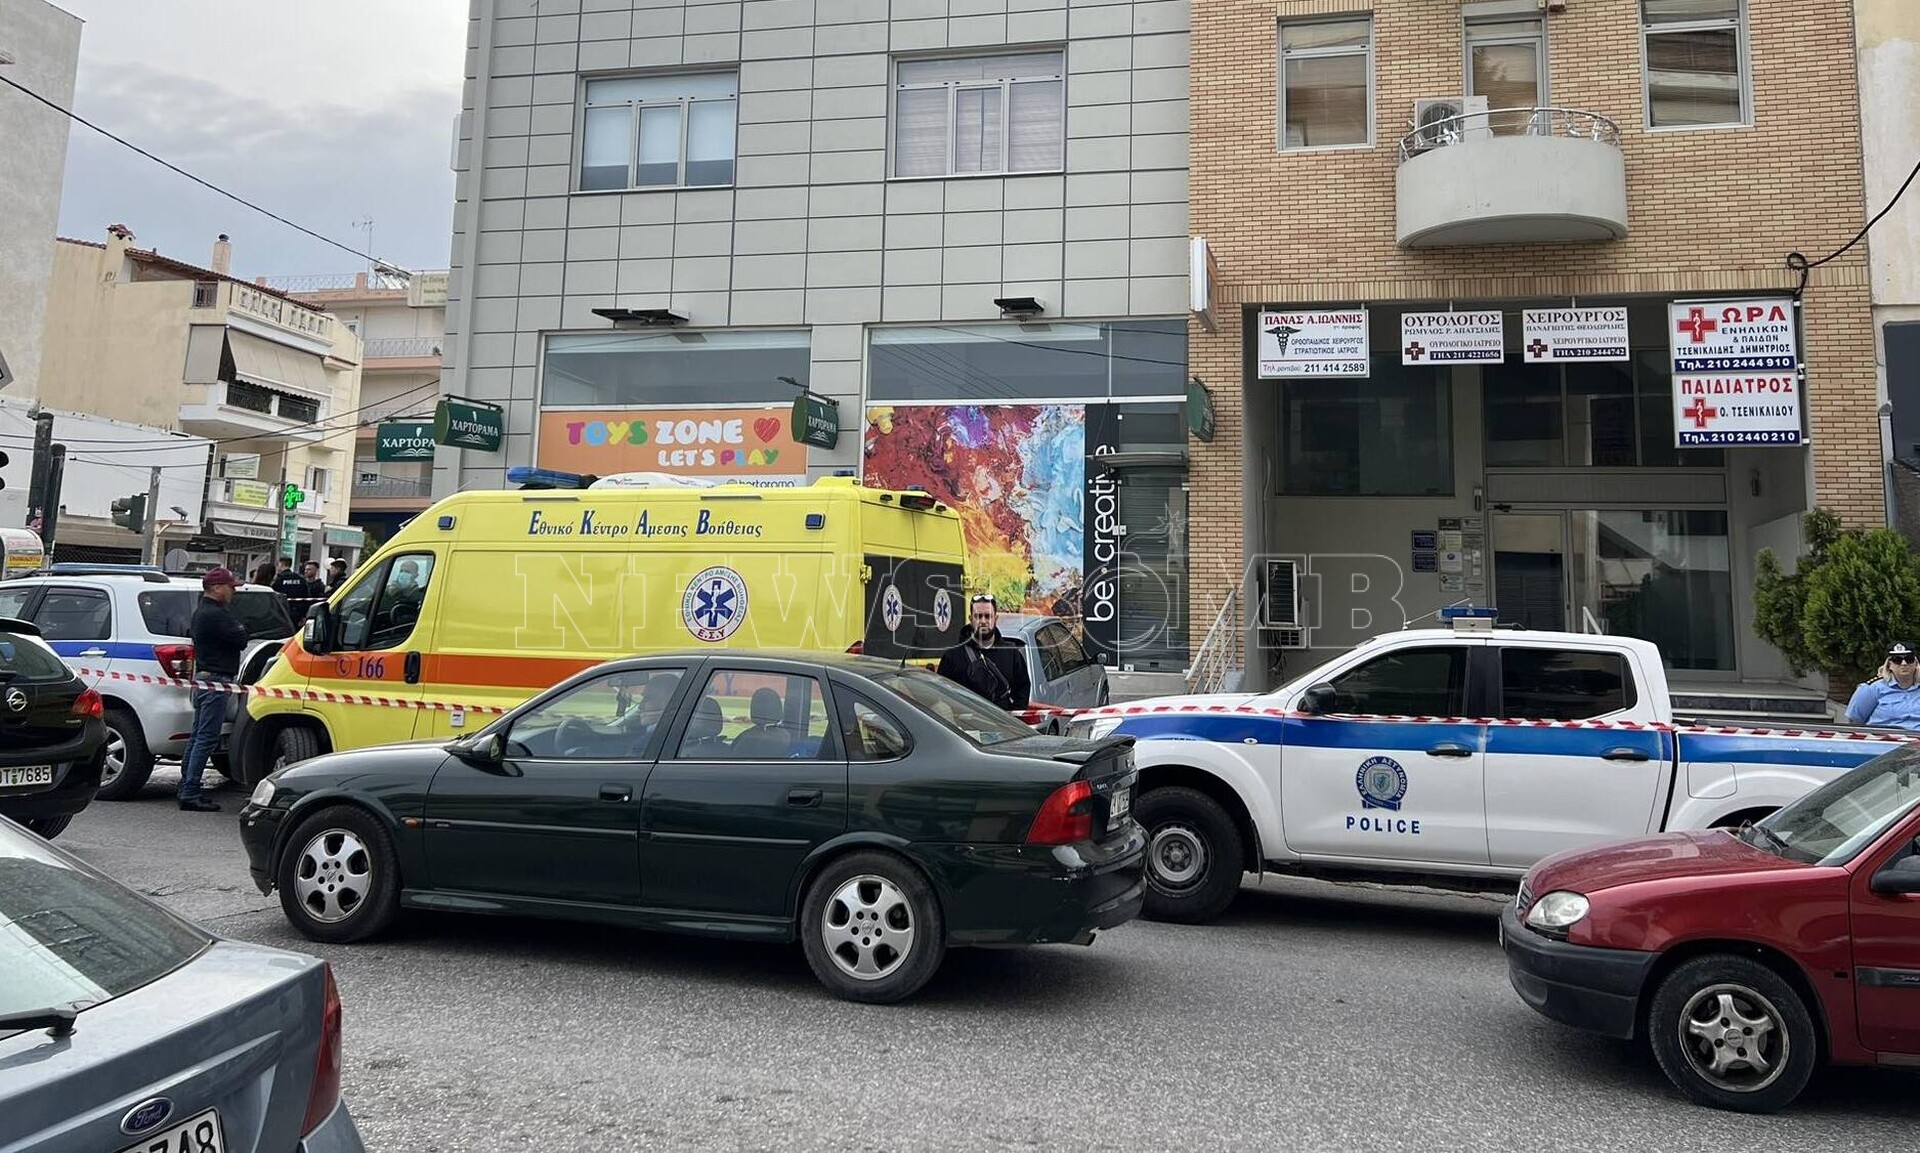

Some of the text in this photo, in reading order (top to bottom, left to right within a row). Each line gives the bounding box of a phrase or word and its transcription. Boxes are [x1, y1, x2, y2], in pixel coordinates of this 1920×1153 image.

[1264, 315, 1304, 325] ΠΑΝΑΣ
[1404, 314, 1500, 327] ΟΥΡΟΛΟΓΟΣ
[1526, 310, 1625, 323] ΧΕΙΡΟΥΡΓΟΣ
[1721, 305, 1787, 323] ΩΡΛ
[1721, 325, 1788, 335] ΕΝΗΛΙΚΩΝ
[1429, 340, 1473, 348] ΟΥΡΟΛΟΓΙΚΟ
[1742, 335, 1779, 343] ΠΑΙΔΩΝ
[1337, 346, 1359, 354] ΙΑΤΡΟΣ
[1677, 344, 1790, 356] ΤΣΕΝΙΚΛΙΔΗΣ ΔΗΜΗΤΡΙΟΣ
[1304, 364, 1320, 372] 211
[1323, 364, 1340, 372] 414
[1342, 363, 1365, 372] 2589
[1679, 360, 1705, 371] Τηλ.
[1707, 360, 1731, 369] 210
[1767, 358, 1791, 366] 910
[1682, 377, 1793, 394] ΠΑΙΔΙΑΤΡΟΣ
[1732, 405, 1794, 417] ΤΣΕΝΙΚΛΙΔΟΥ
[451, 420, 499, 436] ΧΑΡΤΟΡΑΜΑ
[566, 419, 744, 446] TOYS ZONE
[1683, 433, 1709, 444] Τηλ.
[1711, 433, 1735, 442] 210
[1771, 432, 1795, 441] 210
[720, 449, 779, 466] PLAY
[527, 510, 574, 536] Εθνικό
[579, 510, 628, 538] Κέντρο
[695, 509, 763, 538] Βοήθειας
[357, 656, 384, 679] 166
[1357, 758, 1407, 798] ΕΛΛΗΝΙΚΗ ΑΣΤΥΝΟΜΙΑ
[1346, 816, 1420, 834] POLICE
